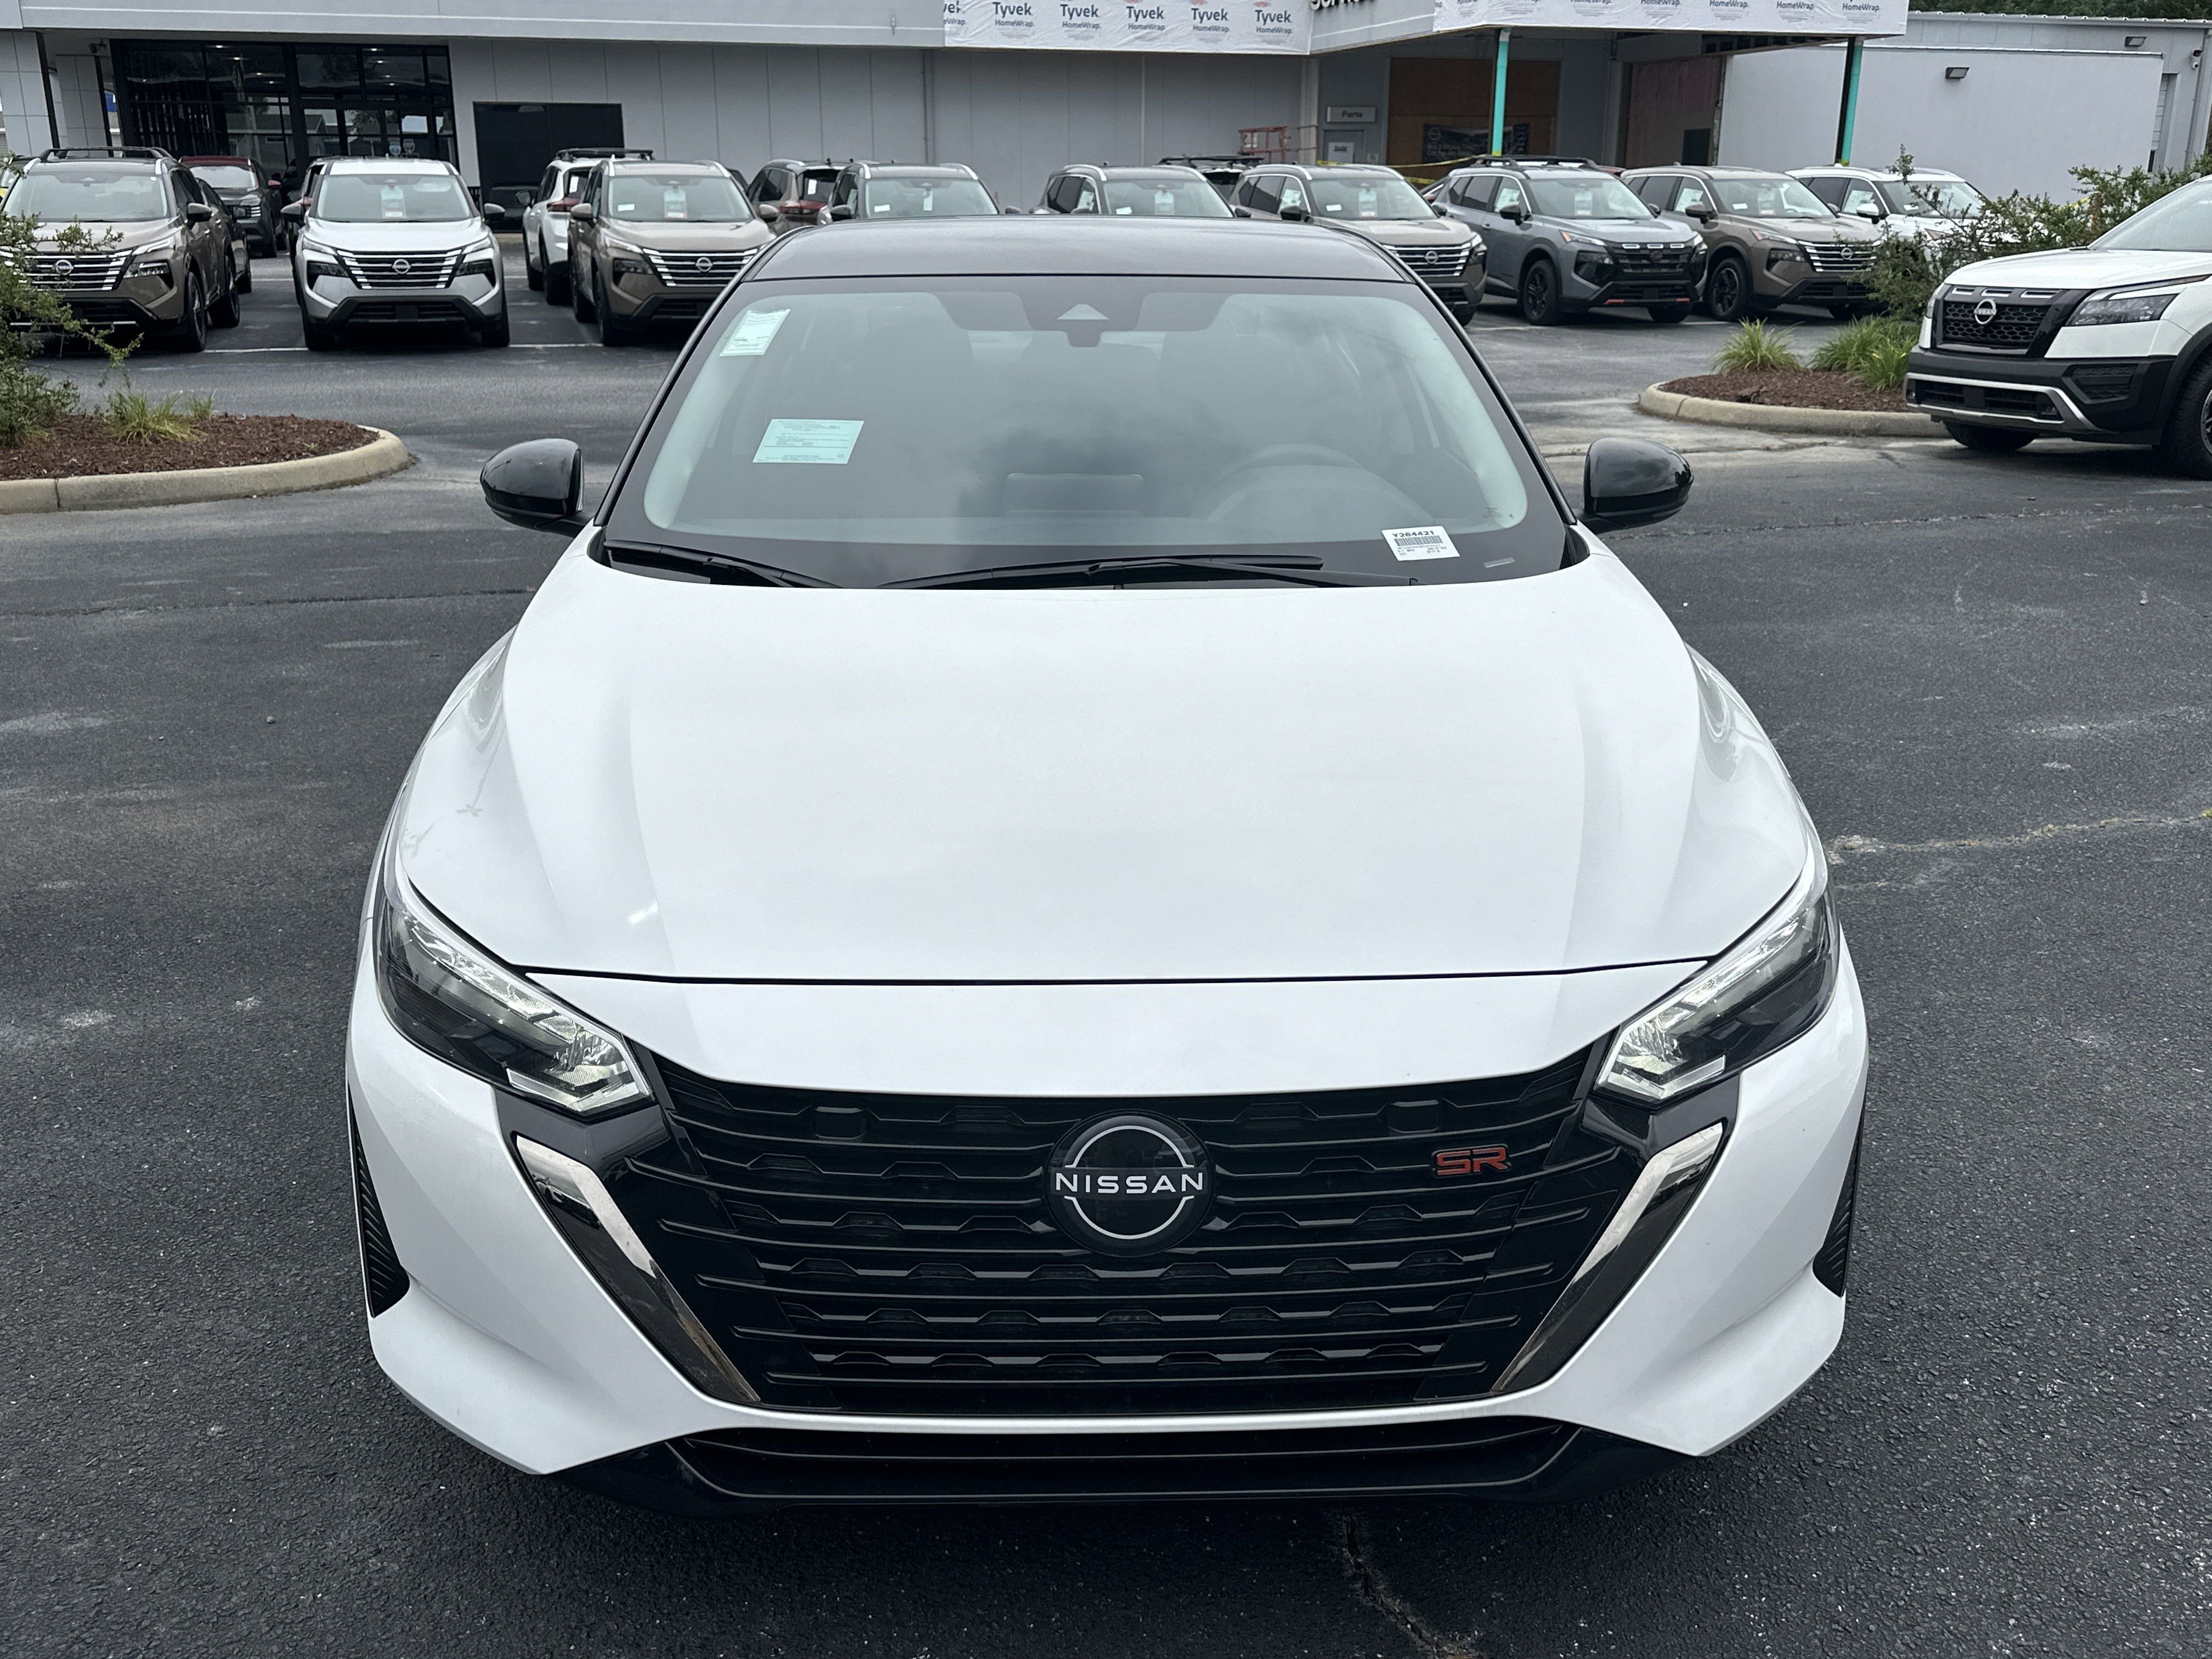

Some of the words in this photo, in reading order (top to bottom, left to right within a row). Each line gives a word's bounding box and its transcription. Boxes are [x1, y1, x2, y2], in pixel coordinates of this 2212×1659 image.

[992, 2, 1032, 18] Tyvek
[1060, 4, 1099, 20] Tyvek
[1776, 1, 1814, 10] HomeWrap
[1842, 3, 1880, 12] HomeWrap
[1126, 6, 1164, 22] Tyvek
[1191, 8, 1228, 24] Tyvek
[1255, 10, 1291, 25] Tyvek
[995, 19, 1034, 27] HomeWrap
[1062, 21, 1100, 29] HomeWrap
[1193, 25, 1229, 33] HomeWrap
[1436, 1147, 1508, 1176] SR
[1056, 1172, 1203, 1194] NISSAN
